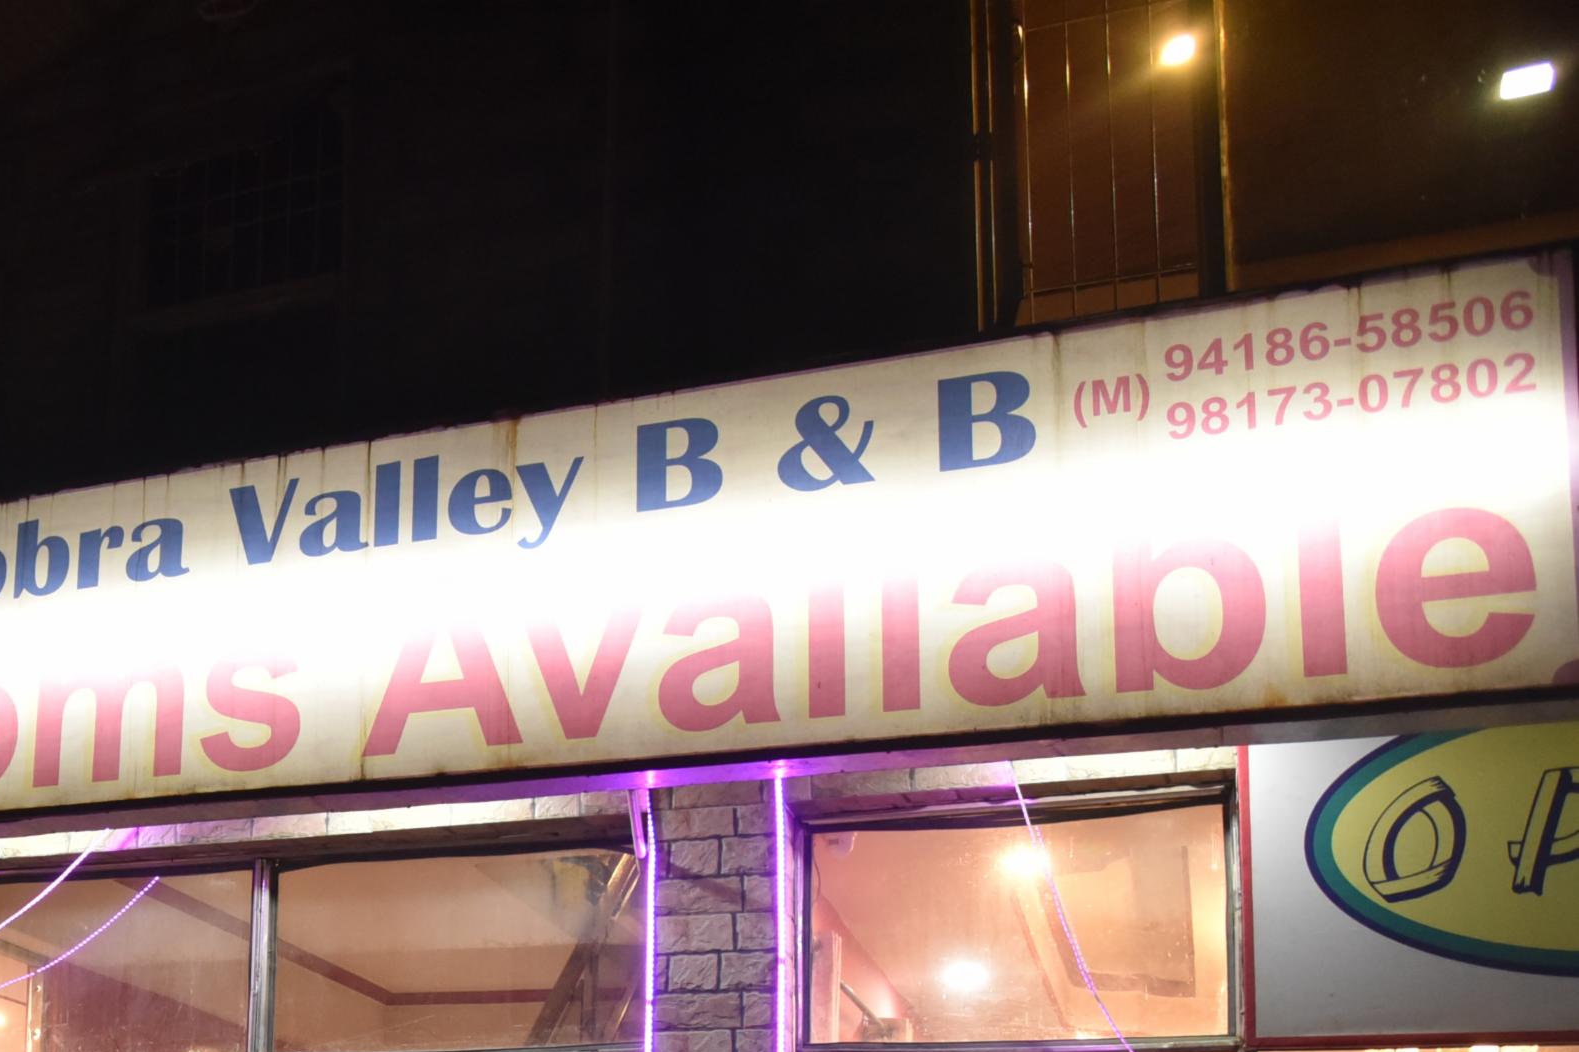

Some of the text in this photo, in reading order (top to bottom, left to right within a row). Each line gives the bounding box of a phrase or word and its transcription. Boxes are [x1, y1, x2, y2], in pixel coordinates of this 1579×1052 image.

[1164, 290, 1535, 382] 94186-58506
[1073, 374, 1151, 428] (M)
[1166, 352, 1537, 440] 98173-07802
[231, 454, 584, 549] Valley
[636, 416, 724, 512] B
[777, 395, 876, 492] &
[937, 370, 1038, 471] B
[362, 507, 1538, 758] Available
